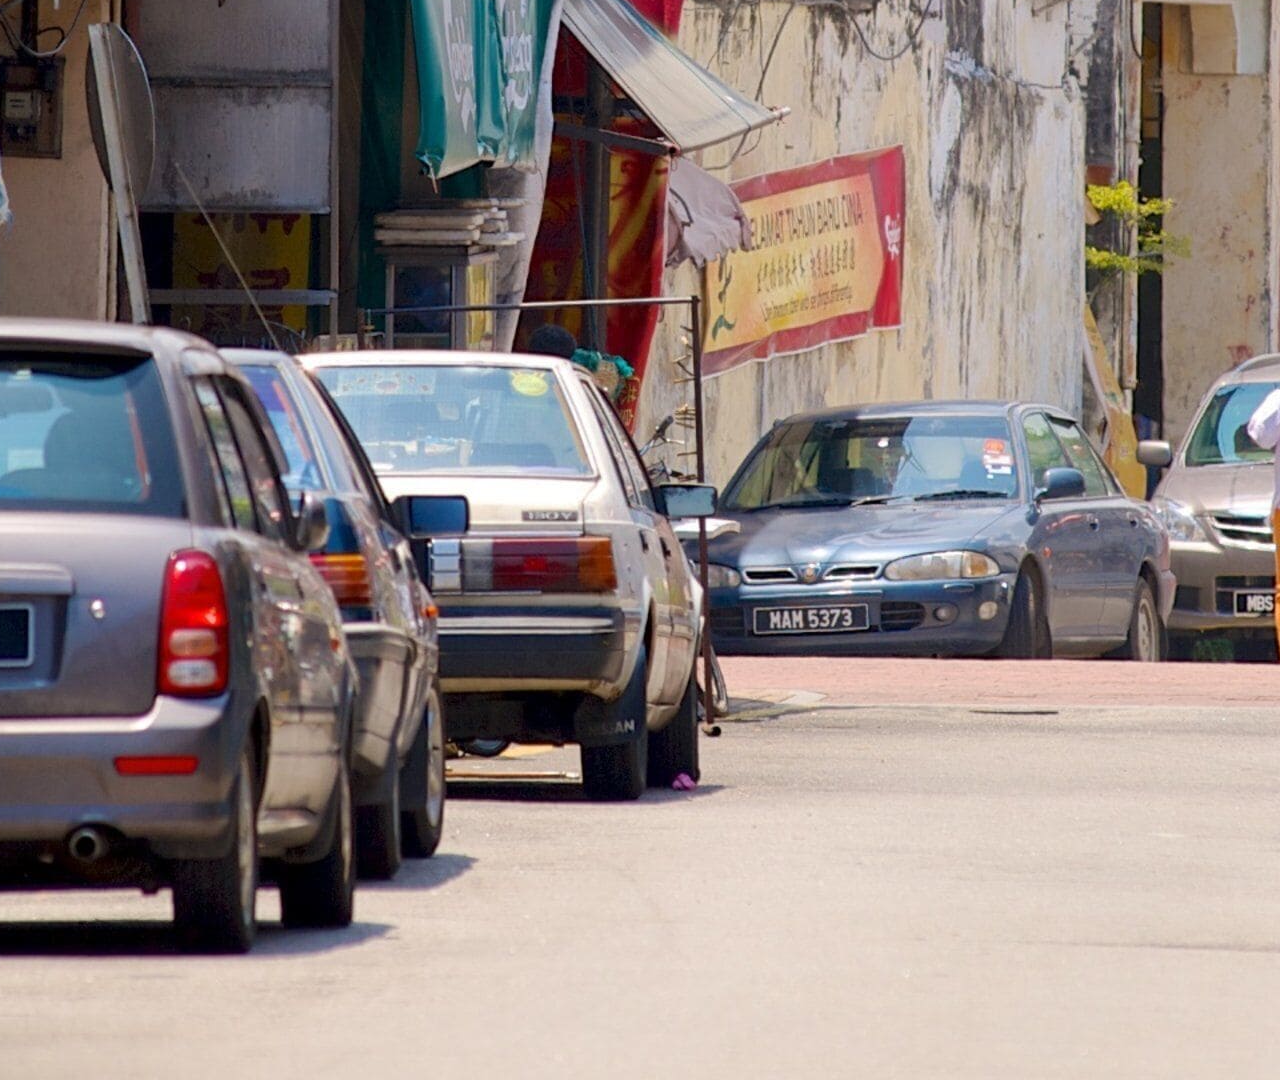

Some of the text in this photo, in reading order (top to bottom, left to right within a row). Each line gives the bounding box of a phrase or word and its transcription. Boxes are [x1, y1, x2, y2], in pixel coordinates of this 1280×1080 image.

[750, 191, 864, 251] ELAMAT TAHUN BARU CINA
[1247, 595, 1274, 612] MBS
[769, 608, 853, 629] MAM 5373
